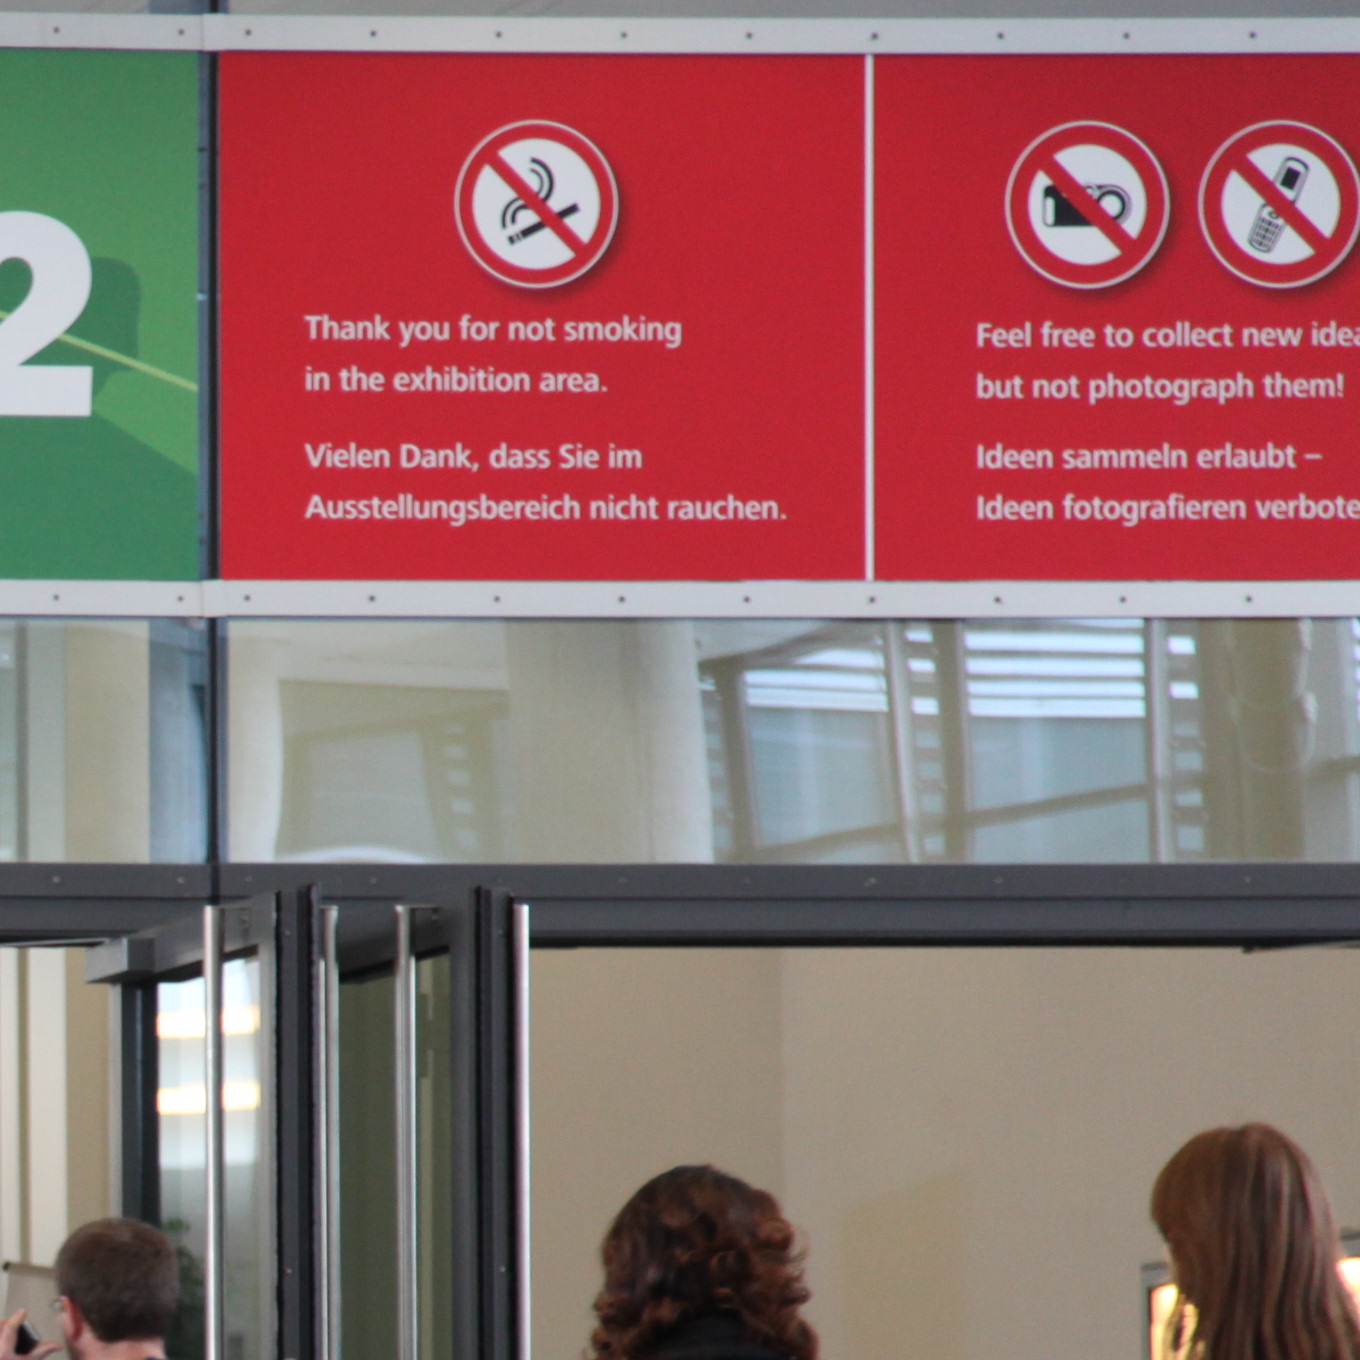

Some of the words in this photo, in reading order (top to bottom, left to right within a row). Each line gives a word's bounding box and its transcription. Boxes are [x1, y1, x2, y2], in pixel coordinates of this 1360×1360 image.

[304, 314, 392, 341] Thank
[398, 320, 451, 348] you
[458, 313, 502, 341] for
[508, 318, 557, 342] not
[563, 315, 683, 349] smoking
[977, 321, 1033, 348] Feel
[1040, 320, 1097, 348] free
[1104, 324, 1136, 348] to
[1142, 321, 1234, 348] collect
[1242, 327, 1304, 347] new
[305, 365, 332, 392] in
[339, 365, 387, 392] the
[393, 365, 532, 393] exhibition
[539, 372, 609, 393] area.
[976, 372, 1025, 399] but
[1032, 375, 1081, 399] not
[1089, 372, 1255, 406] photograph
[1262, 371, 1346, 398] them!
[304, 442, 392, 469] Vielen
[400, 442, 480, 472] Dank,
[489, 442, 552, 469] dass
[559, 443, 601, 469] Sie
[608, 442, 644, 469] im
[977, 442, 1055, 469] Ideen
[1062, 442, 1189, 469] sammeln
[1196, 442, 1298, 469] erlaubt
[304, 493, 582, 527] Ausstellungsbereich
[590, 493, 661, 520] nicht
[667, 493, 788, 521] rauchen.
[977, 493, 1055, 521] Ideen
[1062, 492, 1248, 527] fotografieren
